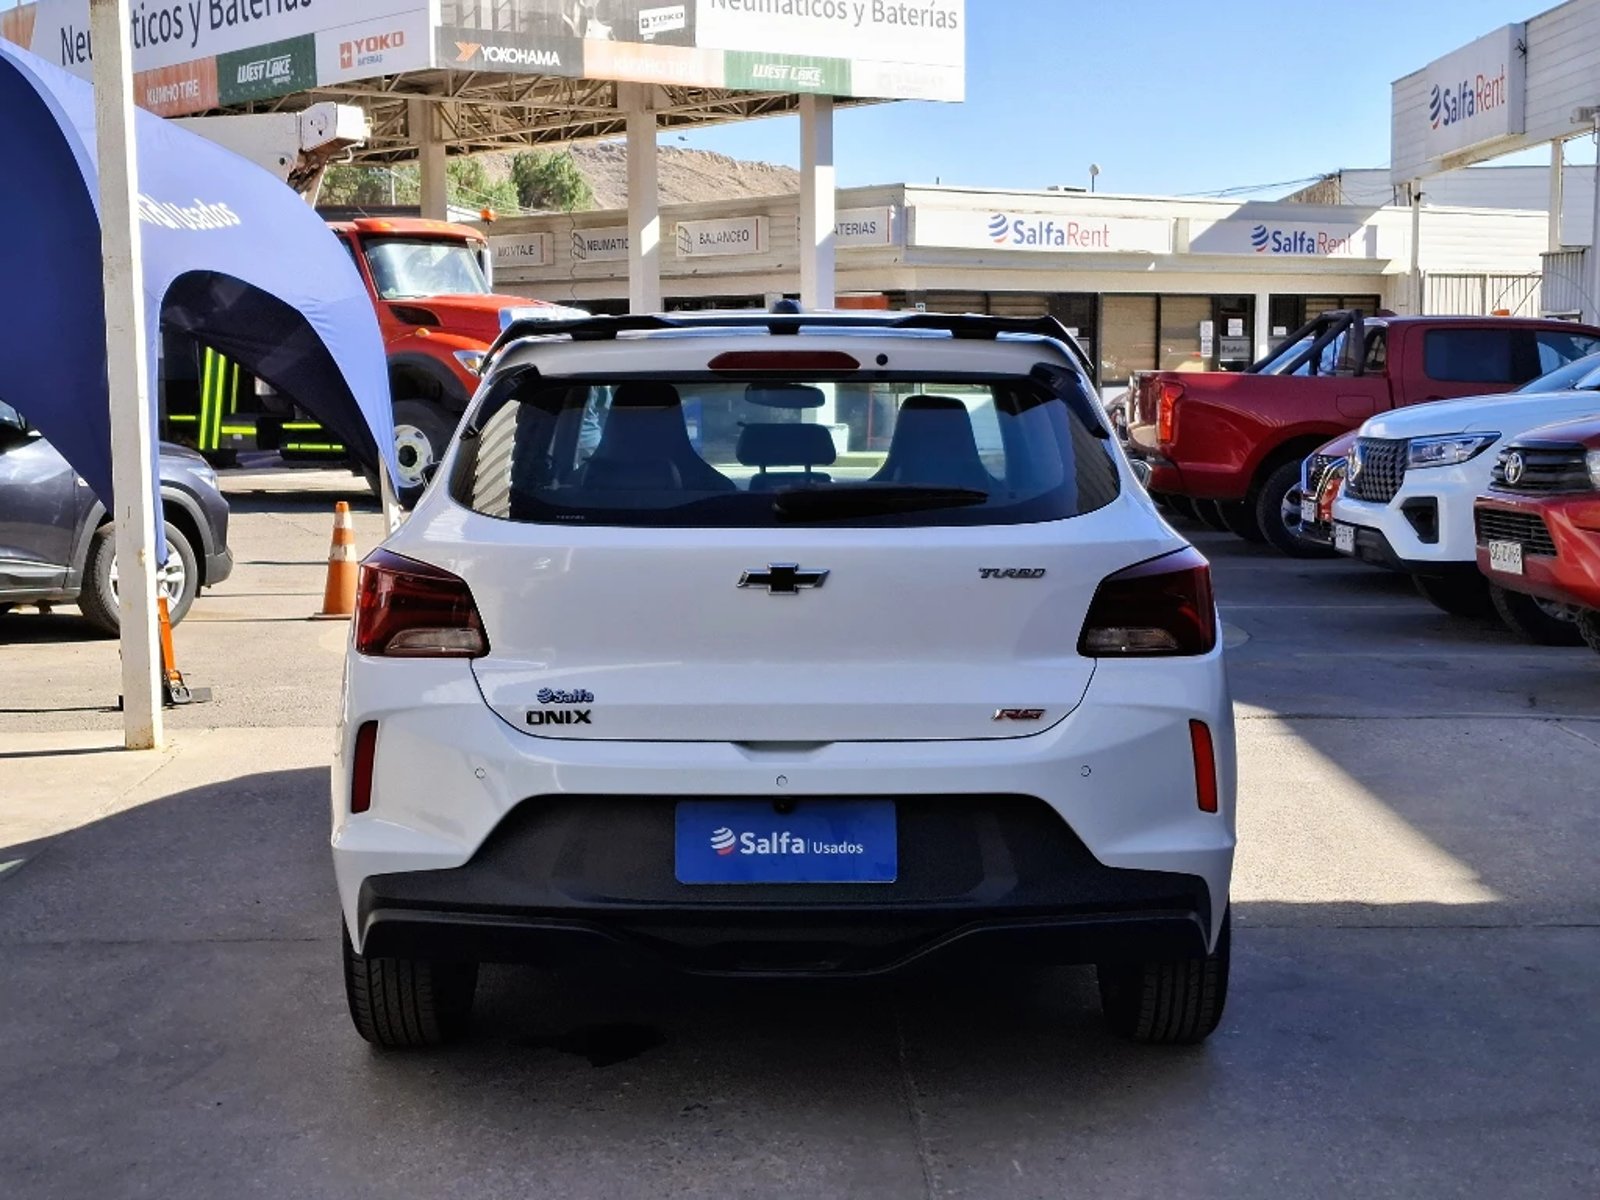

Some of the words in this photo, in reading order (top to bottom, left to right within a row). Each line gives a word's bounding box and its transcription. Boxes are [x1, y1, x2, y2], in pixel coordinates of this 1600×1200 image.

[189, 0, 201, 48] y
[853, 2, 866, 27] y
[872, 0, 958, 29] Baterías
[354, 31, 404, 54] YOKO
[481, 46, 561, 66] YOKOHAMA
[237, 62, 265, 84] WEST
[265, 54, 293, 78] LAKE
[753, 63, 788, 79] WEST
[790, 67, 823, 82] LAKE
[1442, 63, 1505, 126] SalfaRent
[833, 221, 876, 236] ATERIAS
[1013, 219, 1110, 247] SalfaRent
[586, 237, 629, 251] NEUMATIC
[526, 709, 592, 725] ONIX
[740, 831, 805, 855] Salfa
[813, 840, 864, 854] Usados
